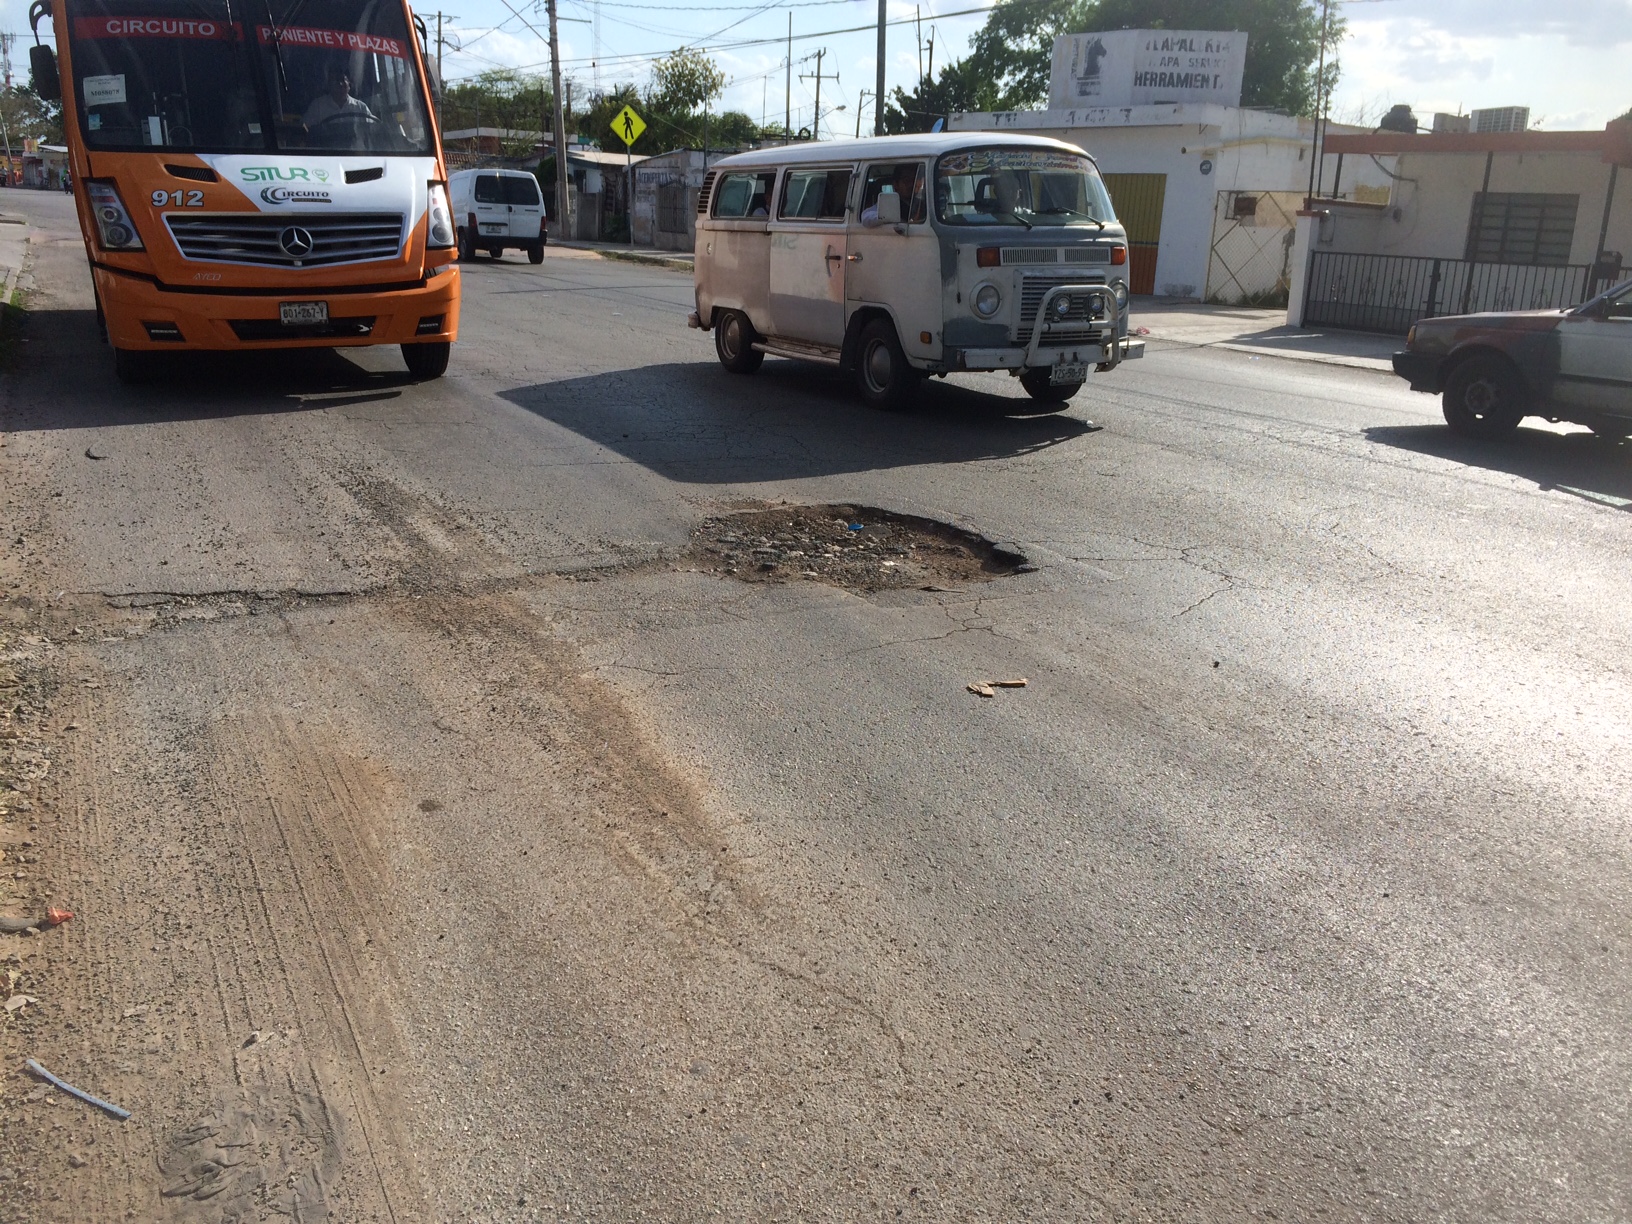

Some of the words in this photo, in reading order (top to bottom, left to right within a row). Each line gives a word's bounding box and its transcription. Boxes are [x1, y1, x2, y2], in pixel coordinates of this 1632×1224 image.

[106, 20, 215, 35] CIRCUITO
[335, 33, 345, 46] Y
[349, 34, 399, 54] PLAZAS
[240, 167, 311, 181] SITUR
[151, 189, 204, 207] 912
[267, 186, 329, 201] CIRCUITO
